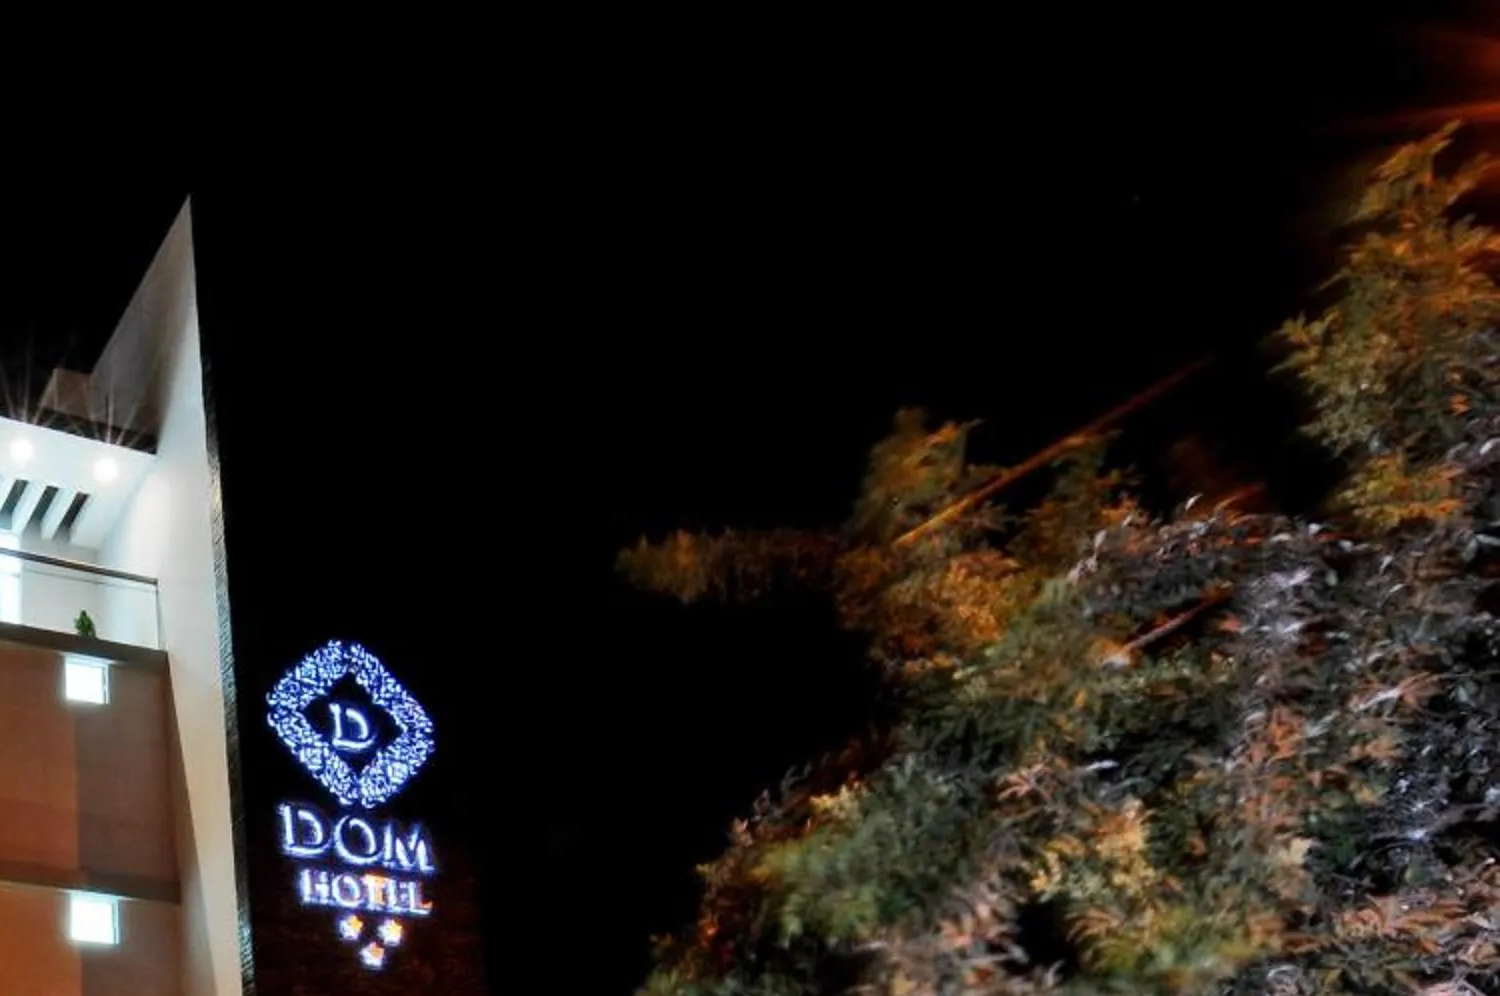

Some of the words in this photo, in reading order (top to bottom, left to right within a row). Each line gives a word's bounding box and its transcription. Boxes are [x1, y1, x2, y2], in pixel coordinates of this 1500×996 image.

[328, 702, 376, 750] D
[277, 802, 436, 872] DOM
[299, 868, 434, 915] HOTEL
